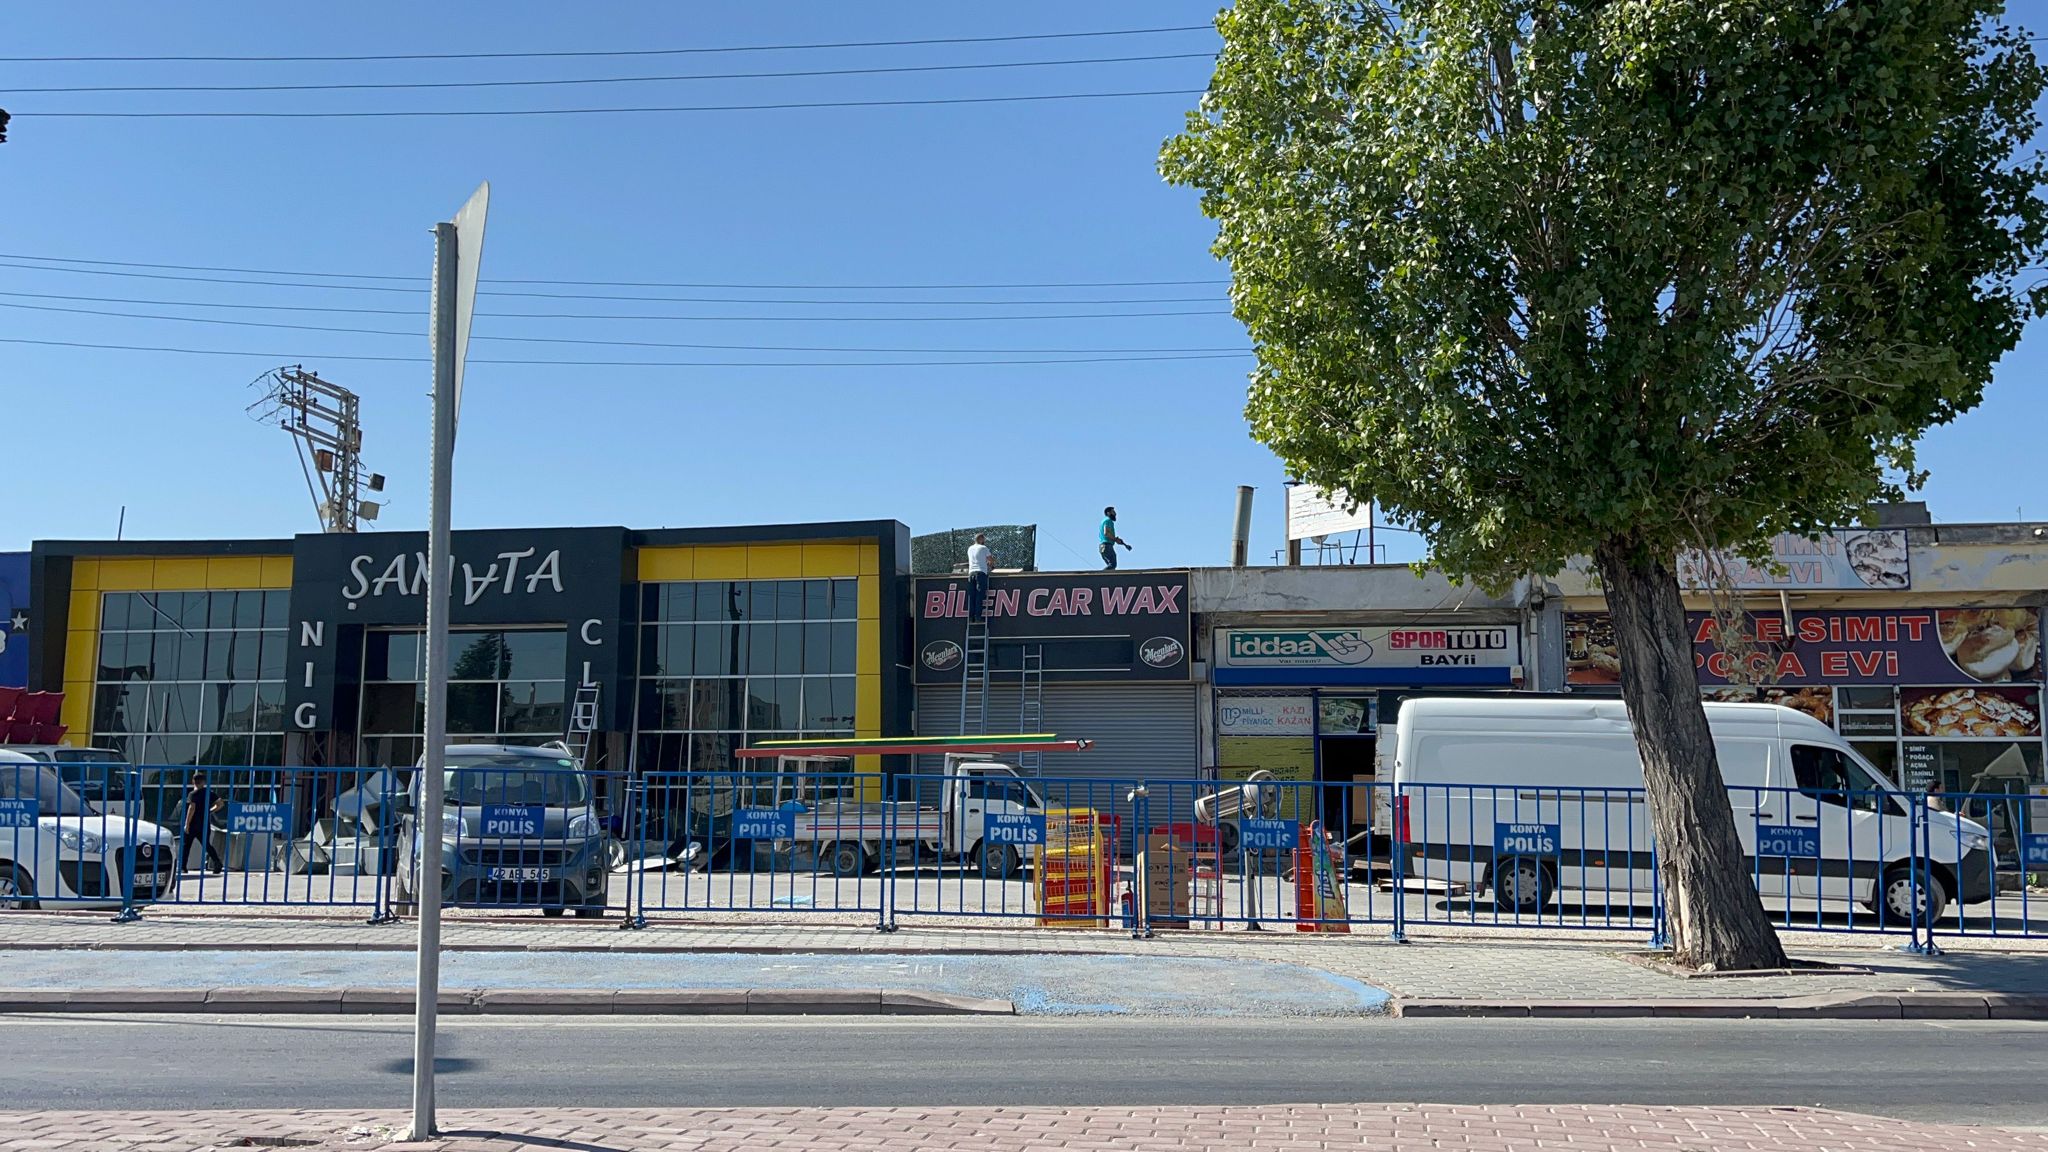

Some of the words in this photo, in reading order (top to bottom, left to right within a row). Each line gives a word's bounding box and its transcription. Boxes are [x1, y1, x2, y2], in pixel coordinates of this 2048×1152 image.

[924, 583, 1021, 618] BİLEN
[1027, 588, 1093, 616] CAR
[1101, 585, 1183, 615] WAX
[1234, 636, 1317, 655] iddaa
[0, 801, 25, 809] ONYA
[242, 804, 276, 813] KONYA
[494, 808, 528, 816] KONYA
[0, 810, 31, 827] OLİS
[234, 815, 283, 831] POLİS
[746, 812, 780, 820] KONYA
[996, 815, 1031, 824] KONYA
[487, 817, 535, 835] POLİS
[739, 821, 787, 837] POLİS
[1250, 820, 1285, 829] KONYA
[1510, 824, 1547, 834] KONYA
[1770, 828, 1803, 836] KONYA
[990, 824, 1037, 842] POLİS
[1243, 830, 1291, 847] POLİS
[1503, 834, 1554, 852] POLİS
[1760, 837, 1816, 855] POLİS
